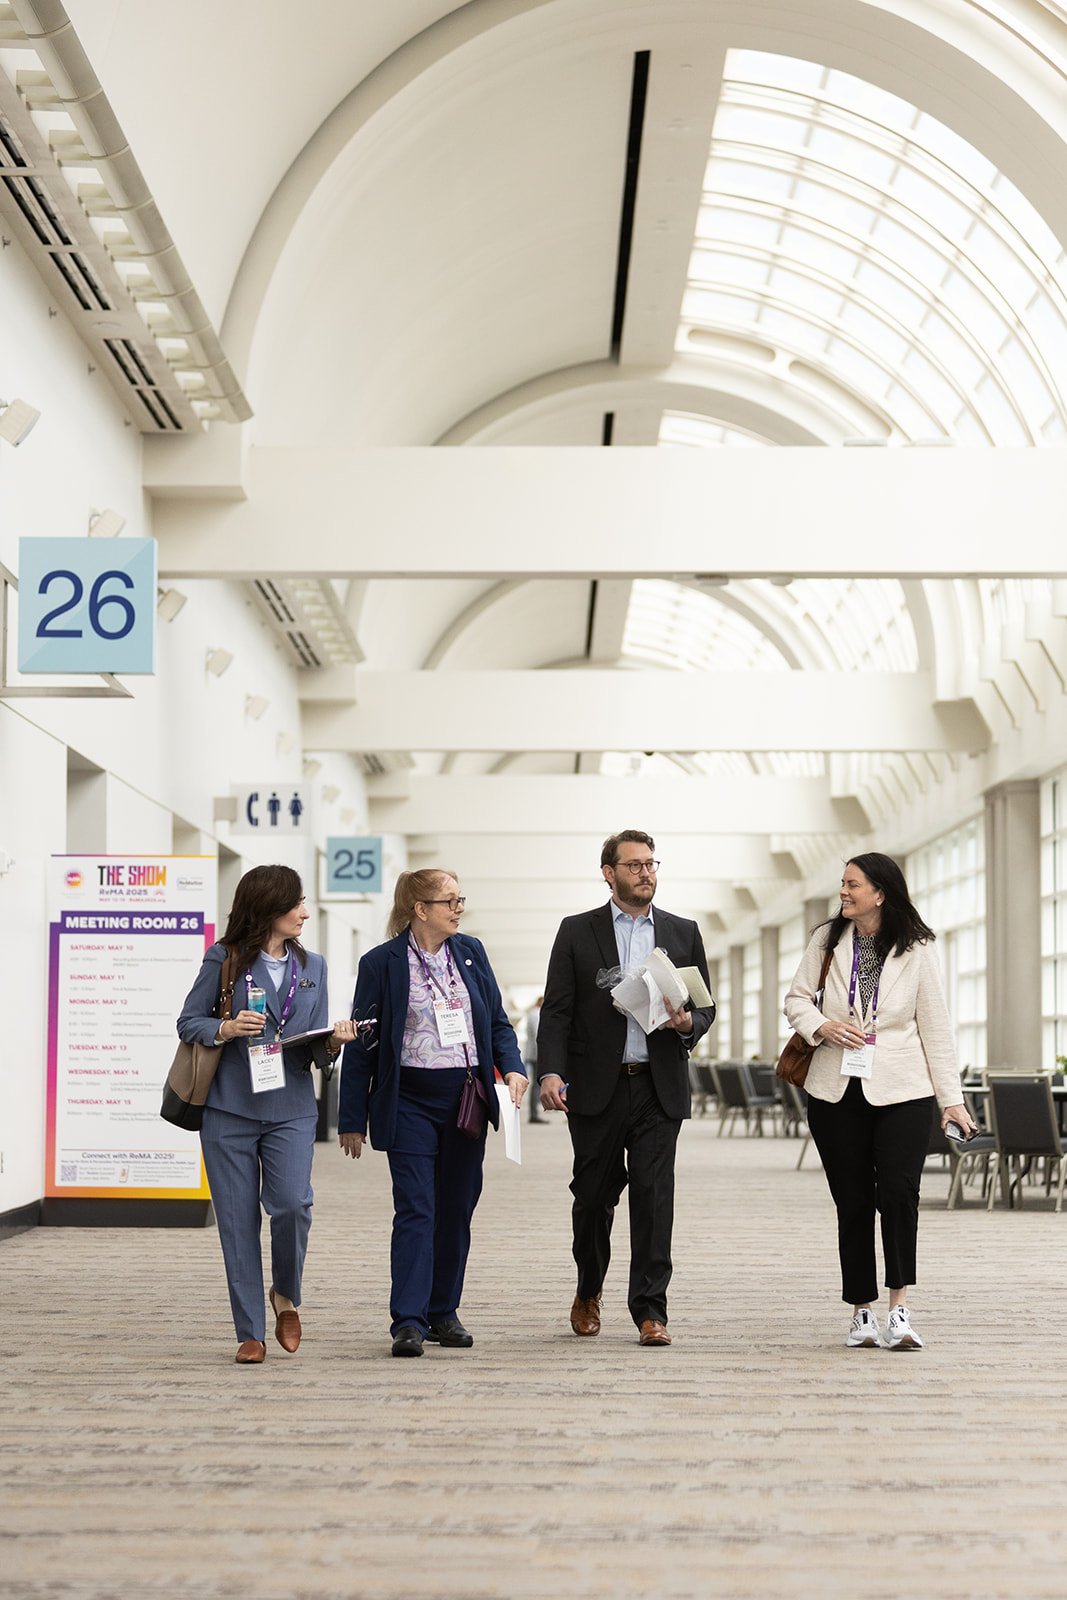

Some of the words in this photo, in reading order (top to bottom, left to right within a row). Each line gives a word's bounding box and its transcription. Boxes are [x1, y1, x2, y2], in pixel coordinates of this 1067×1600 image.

[36, 569, 136, 641] 26
[333, 849, 376, 880] 25
[97, 865, 125, 886] THE
[128, 865, 167, 886] SHOW
[65, 916, 130, 929] MEETING
[132, 917, 177, 929] ROOM
[180, 917, 199, 929] 26
[440, 1012, 459, 1020] TERESA
[257, 1057, 275, 1066] LACEY
[81, 1152, 111, 1160] Connect
[112, 1152, 128, 1160] with
